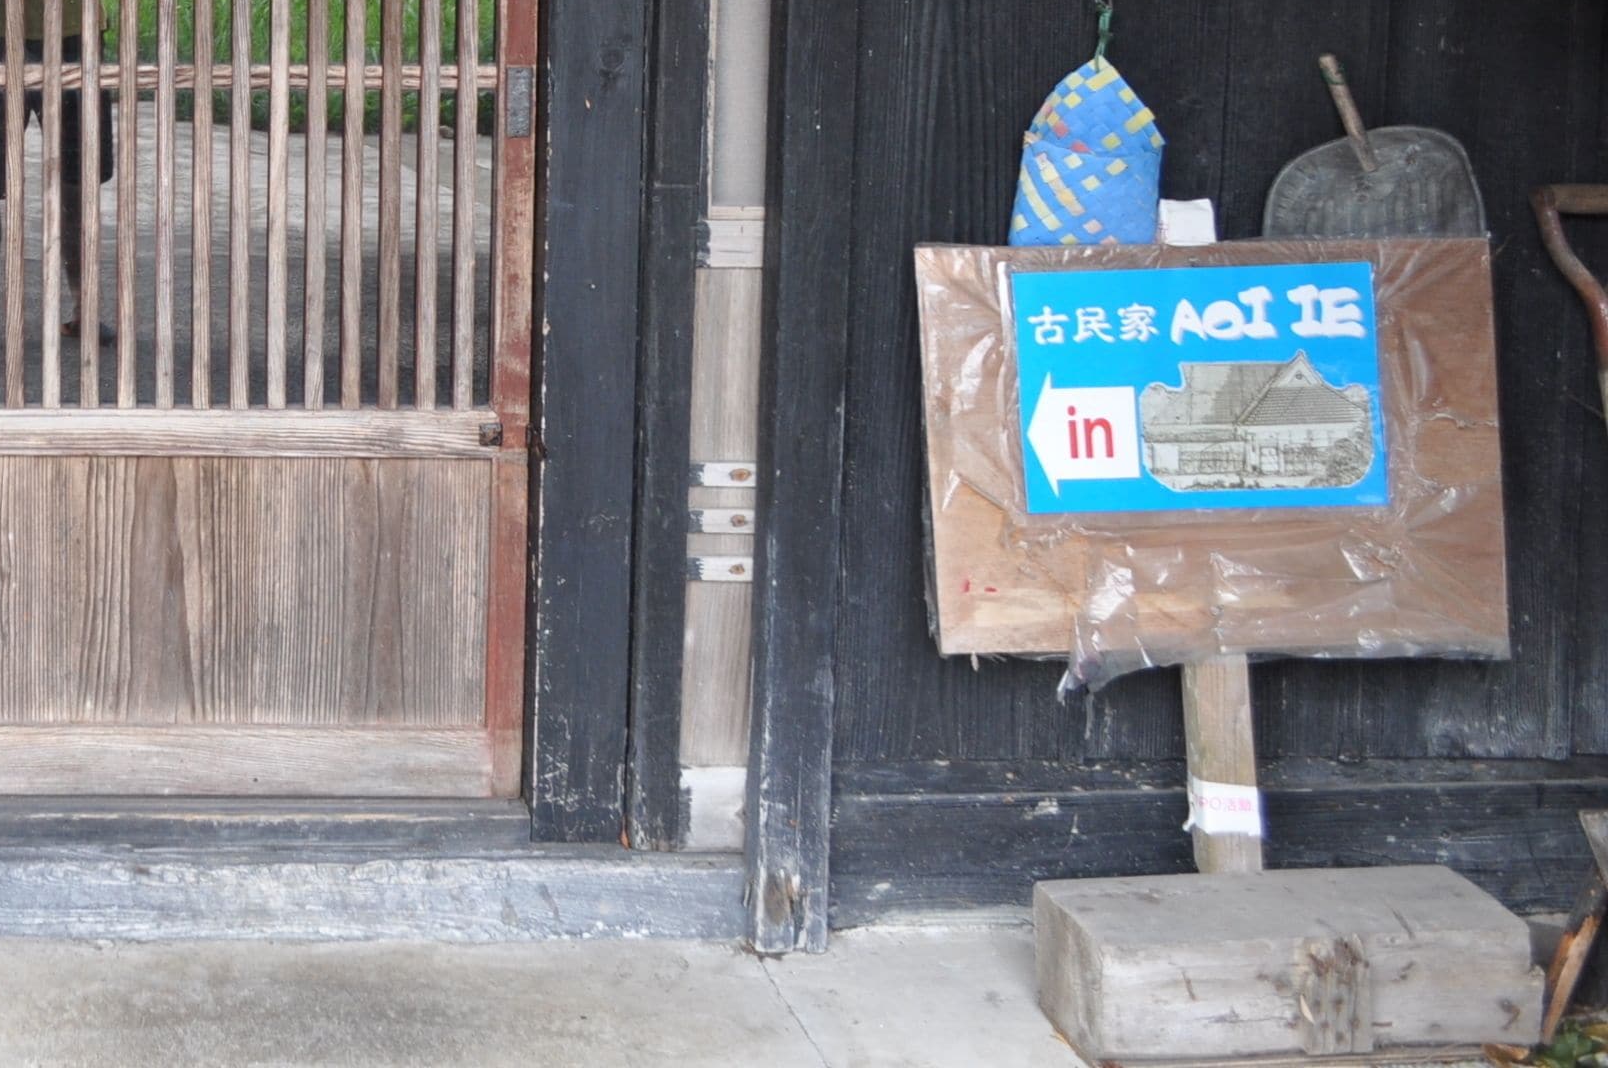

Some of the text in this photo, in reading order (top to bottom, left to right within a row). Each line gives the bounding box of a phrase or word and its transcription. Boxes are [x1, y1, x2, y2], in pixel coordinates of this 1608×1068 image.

[1027, 284, 1367, 345] 古民家 AOI IE
[1067, 406, 1114, 459] in
